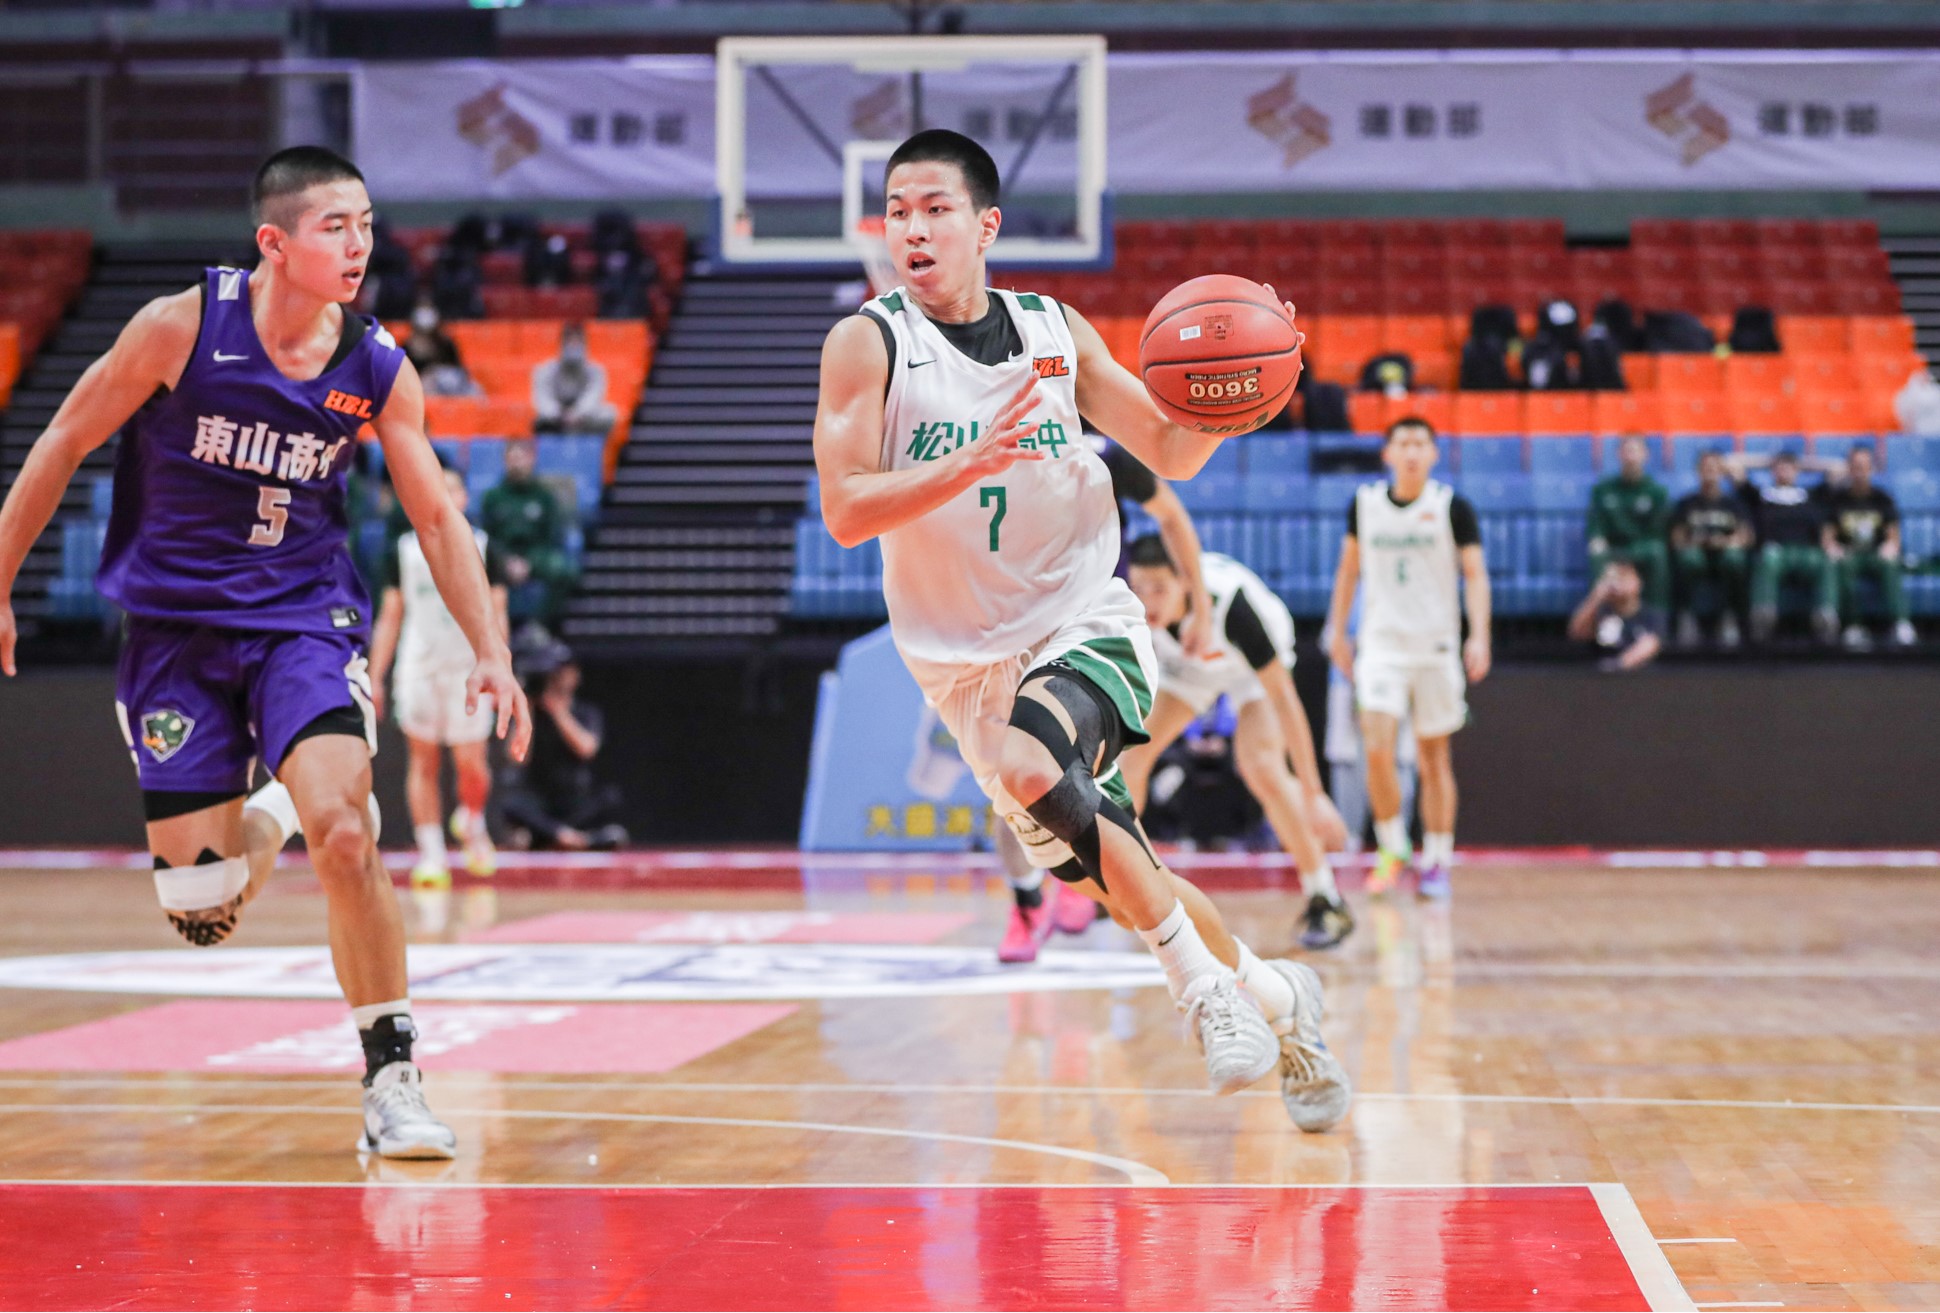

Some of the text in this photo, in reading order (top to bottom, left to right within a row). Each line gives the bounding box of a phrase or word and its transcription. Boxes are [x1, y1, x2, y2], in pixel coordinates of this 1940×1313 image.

[323, 389, 372, 419] HBL
[1190, 377, 1259, 398] 3600
[247, 485, 292, 547] 5
[980, 486, 1007, 552] 7
